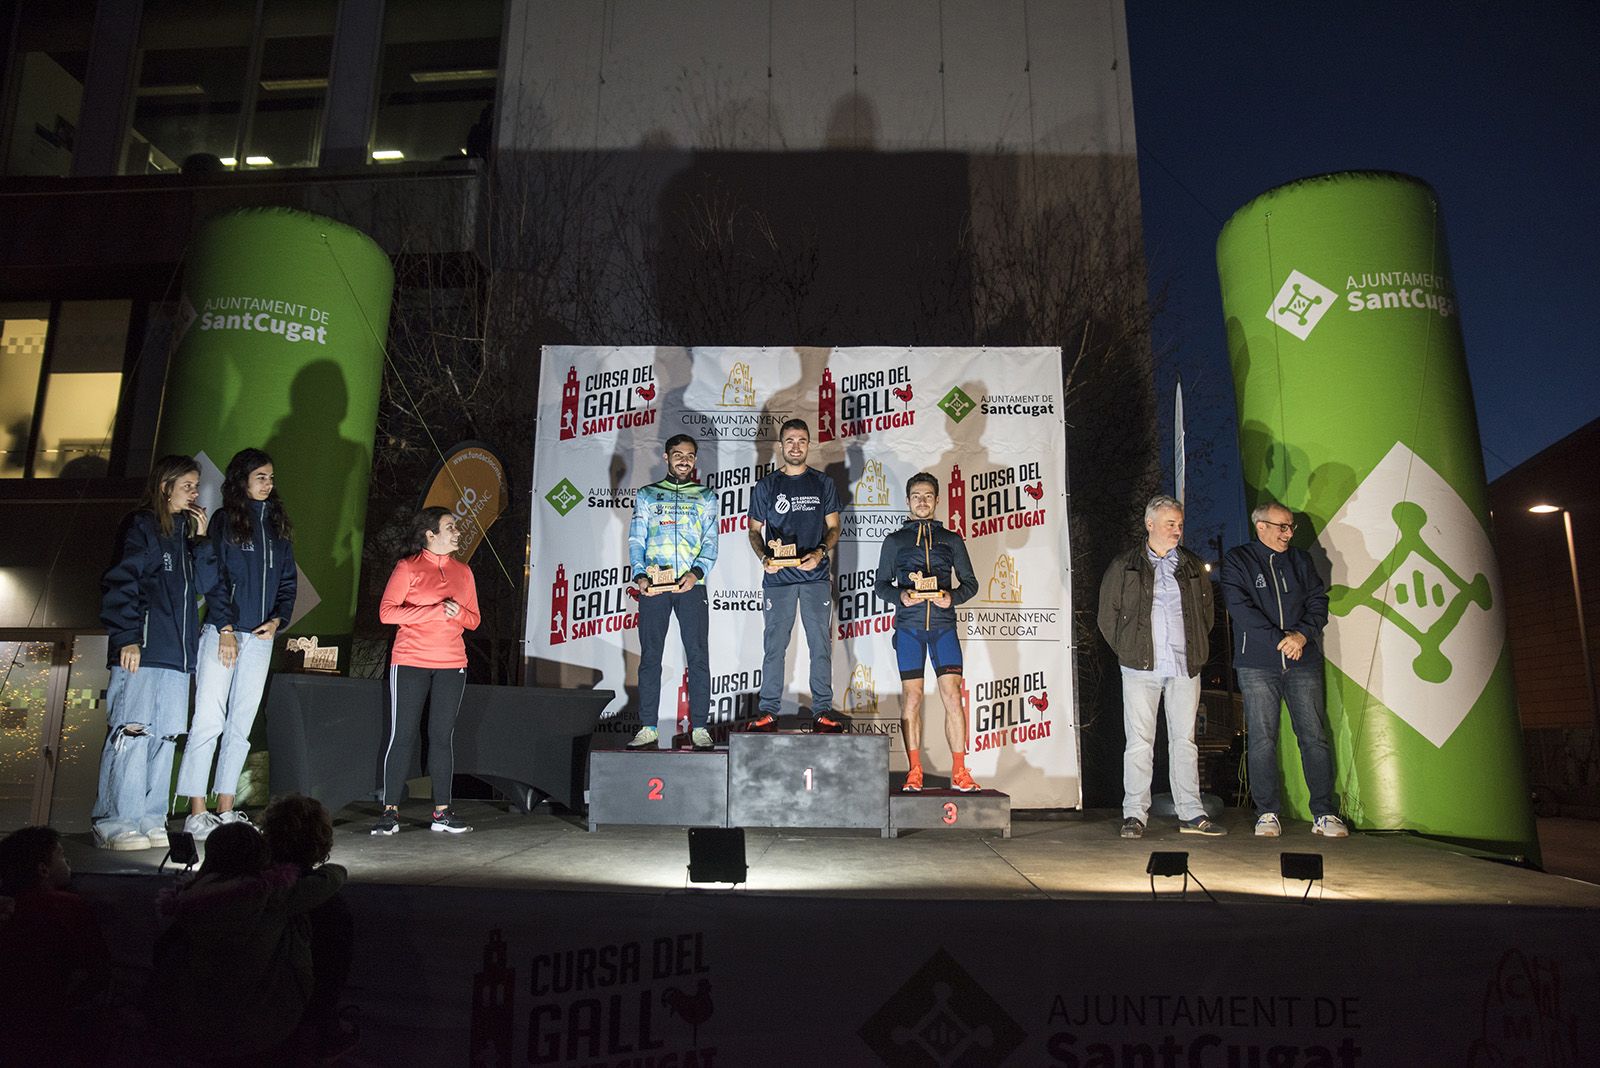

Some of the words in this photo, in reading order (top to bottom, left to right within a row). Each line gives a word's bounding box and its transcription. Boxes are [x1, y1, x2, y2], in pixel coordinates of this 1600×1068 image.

[203, 296, 307, 318] AJUNTAMENT
[310, 308, 330, 325] DE
[1347, 288, 1457, 317] SantCuga
[200, 312, 328, 345] SantCugat
[585, 369, 629, 392] CURSA
[632, 365, 655, 384] DEL
[841, 371, 884, 394] CURSA
[888, 365, 911, 385] DEL
[583, 387, 637, 419] GALL
[841, 389, 895, 421] GALL
[980, 395, 1040, 403] AJUNTAMENT
[1042, 395, 1053, 403] DE
[980, 403, 1054, 417] SantCugat
[581, 416, 615, 436] SANT
[616, 409, 657, 430] CUGAT
[681, 414, 708, 425] CLUB
[710, 415, 789, 425] MUNTANYENC
[700, 427, 729, 437] SANT
[731, 427, 769, 437] CUGAT
[840, 418, 874, 439] SANT
[875, 410, 916, 432] CUGAT
[706, 466, 750, 490] CURSA
[971, 467, 1015, 492] CURSA
[1019, 462, 1042, 482] DEL
[587, 496, 637, 509] SantCu
[588, 487, 638, 497] AJUNTAME
[971, 486, 1027, 520] GALL
[840, 527, 863, 537] ANT
[971, 516, 1005, 539] SANT
[1007, 509, 1046, 530] CUGAT
[573, 567, 619, 592] CURSA
[838, 568, 879, 593] CURS
[572, 587, 627, 621] GALL
[712, 599, 764, 611] SantCu
[713, 590, 763, 599] AJUNTAME
[838, 590, 895, 622] GALL
[571, 618, 604, 640] SANT
[605, 612, 640, 633] CUGA
[837, 618, 872, 641] SANT
[955, 612, 975, 623] LUB
[977, 612, 1057, 624] MUNTANYENC
[967, 625, 997, 636] SANT
[999, 626, 1038, 636] CUGAT
[712, 672, 749, 695] URSA
[975, 676, 1020, 702] CURSA
[1023, 671, 1047, 693] DEL
[975, 697, 1031, 733] GALL
[974, 729, 1009, 753] SANT
[1010, 720, 1052, 745] CUGAT
[647, 778, 664, 801] 2
[803, 767, 814, 791] 1
[942, 802, 959, 825] 3
[530, 942, 641, 997] CURSA
[652, 932, 710, 980] DEL
[1047, 994, 1302, 1028] AJUNTAMENT
[1313, 996, 1362, 1030] DE
[527, 989, 665, 1065] GALL
